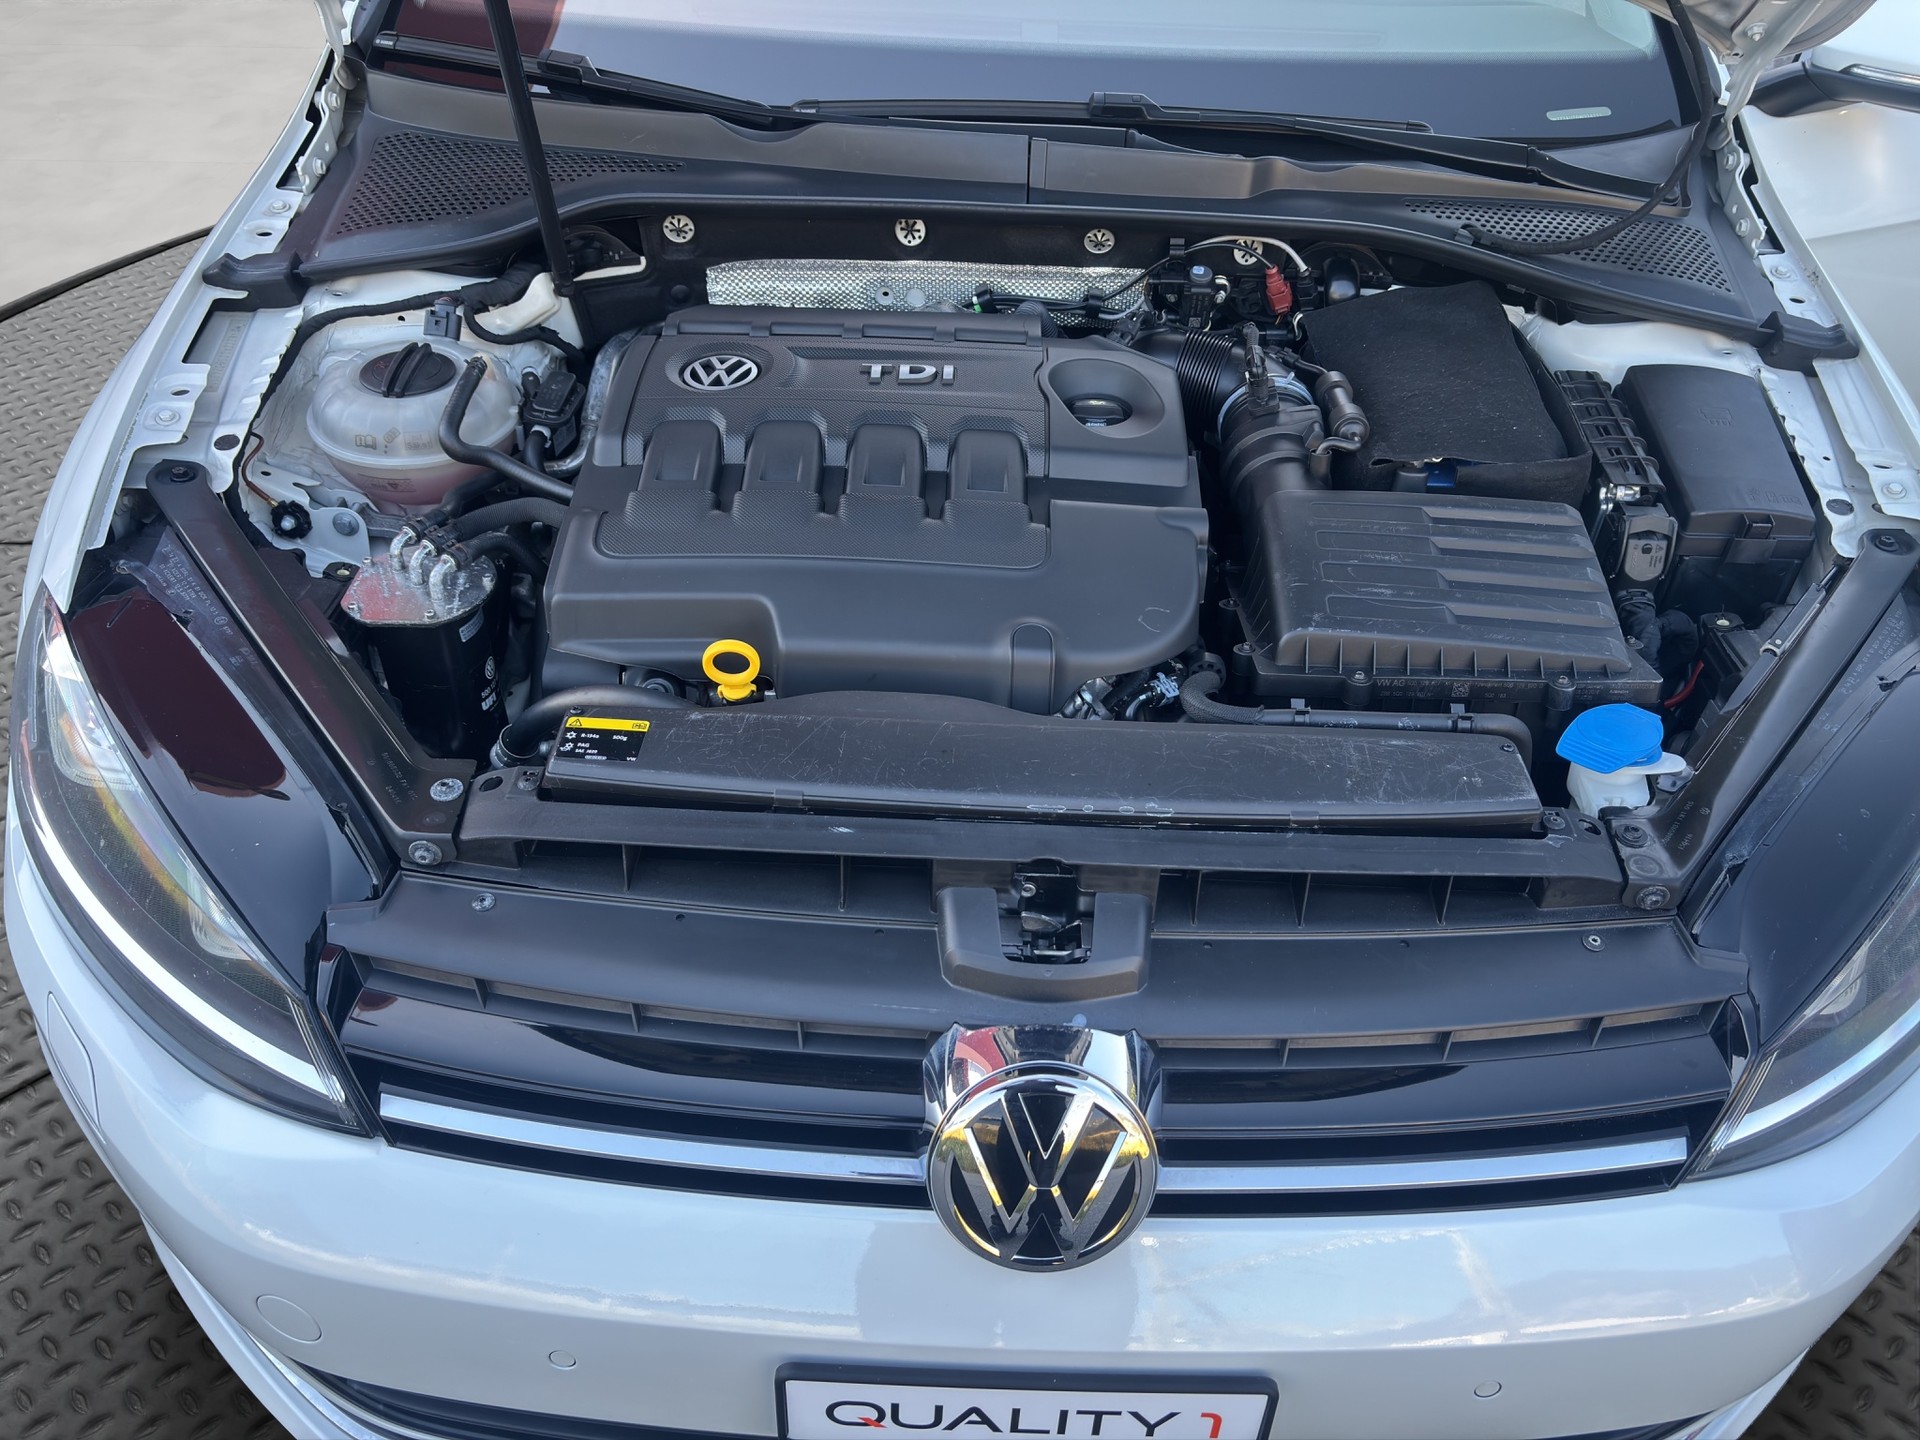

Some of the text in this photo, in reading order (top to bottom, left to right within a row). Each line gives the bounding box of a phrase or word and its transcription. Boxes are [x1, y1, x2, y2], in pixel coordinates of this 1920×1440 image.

[860, 363, 955, 385] TDI
[824, 1400, 1223, 1439] QUALITY 1
